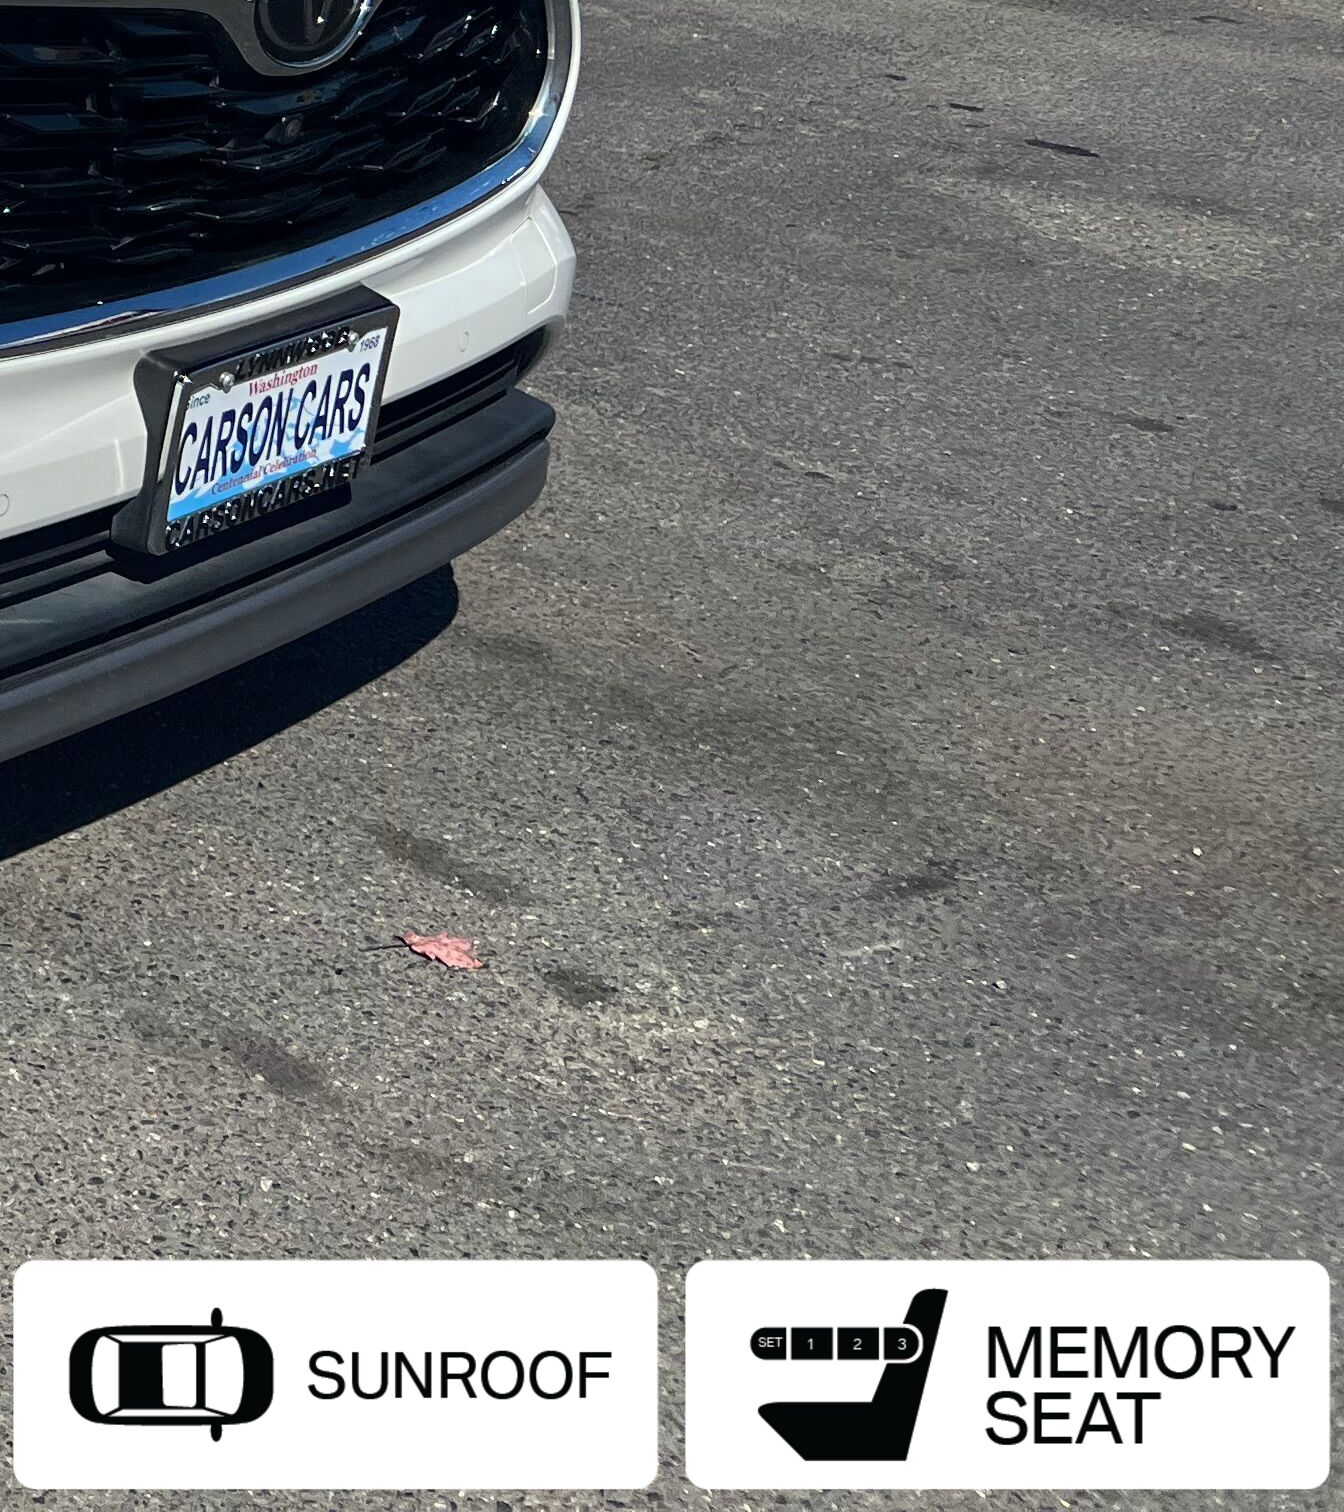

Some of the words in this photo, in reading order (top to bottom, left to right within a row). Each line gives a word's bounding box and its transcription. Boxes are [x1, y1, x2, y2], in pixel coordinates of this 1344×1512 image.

[248, 363, 319, 397] Washington
[188, 393, 211, 410] ince
[174, 388, 294, 496] CARSON
[294, 362, 371, 451] CARS
[211, 466, 262, 496] Centennial
